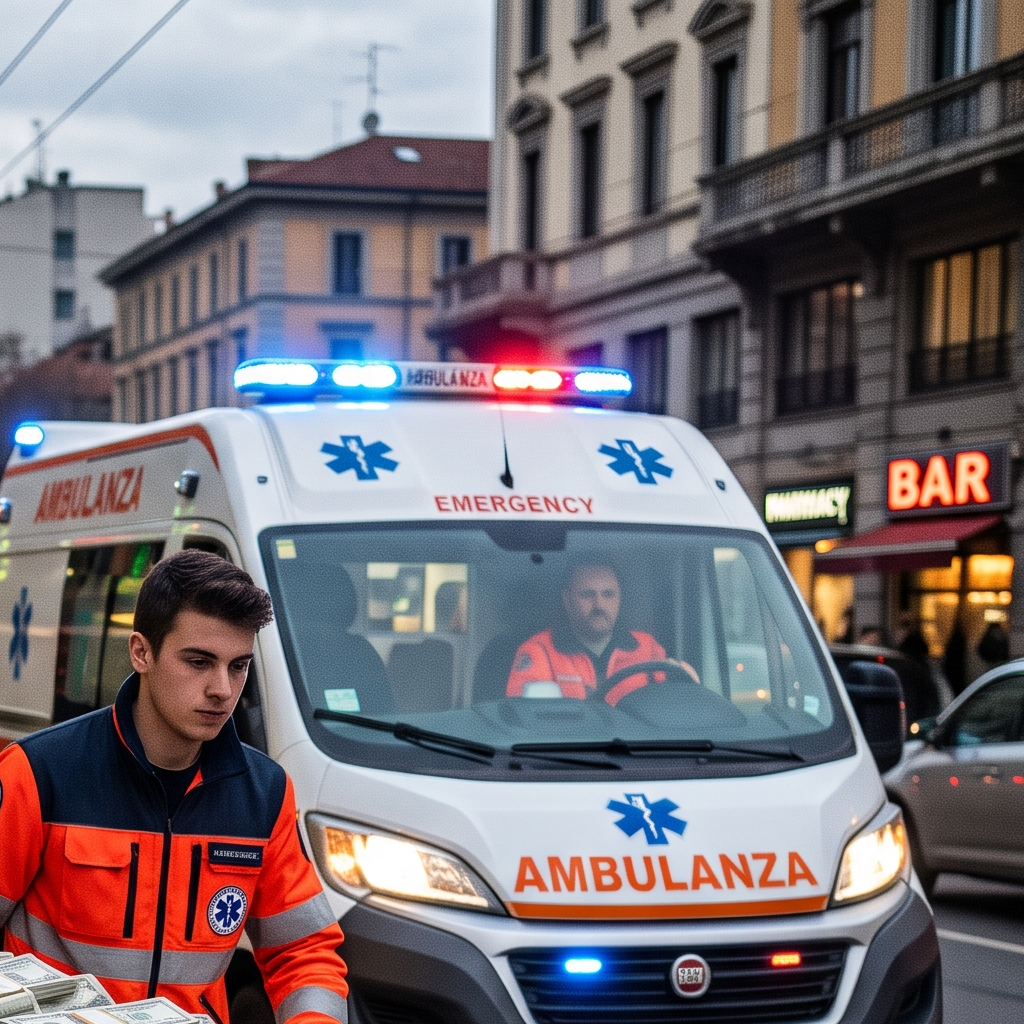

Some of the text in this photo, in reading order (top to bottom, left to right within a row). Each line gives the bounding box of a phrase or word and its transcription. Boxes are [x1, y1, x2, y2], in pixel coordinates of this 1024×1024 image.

[33, 464, 145, 524] AMBULANZA
[433, 494, 594, 514] EMERGENCY
[887, 450, 991, 511] BAR
[513, 851, 819, 893] AMBULANZA
